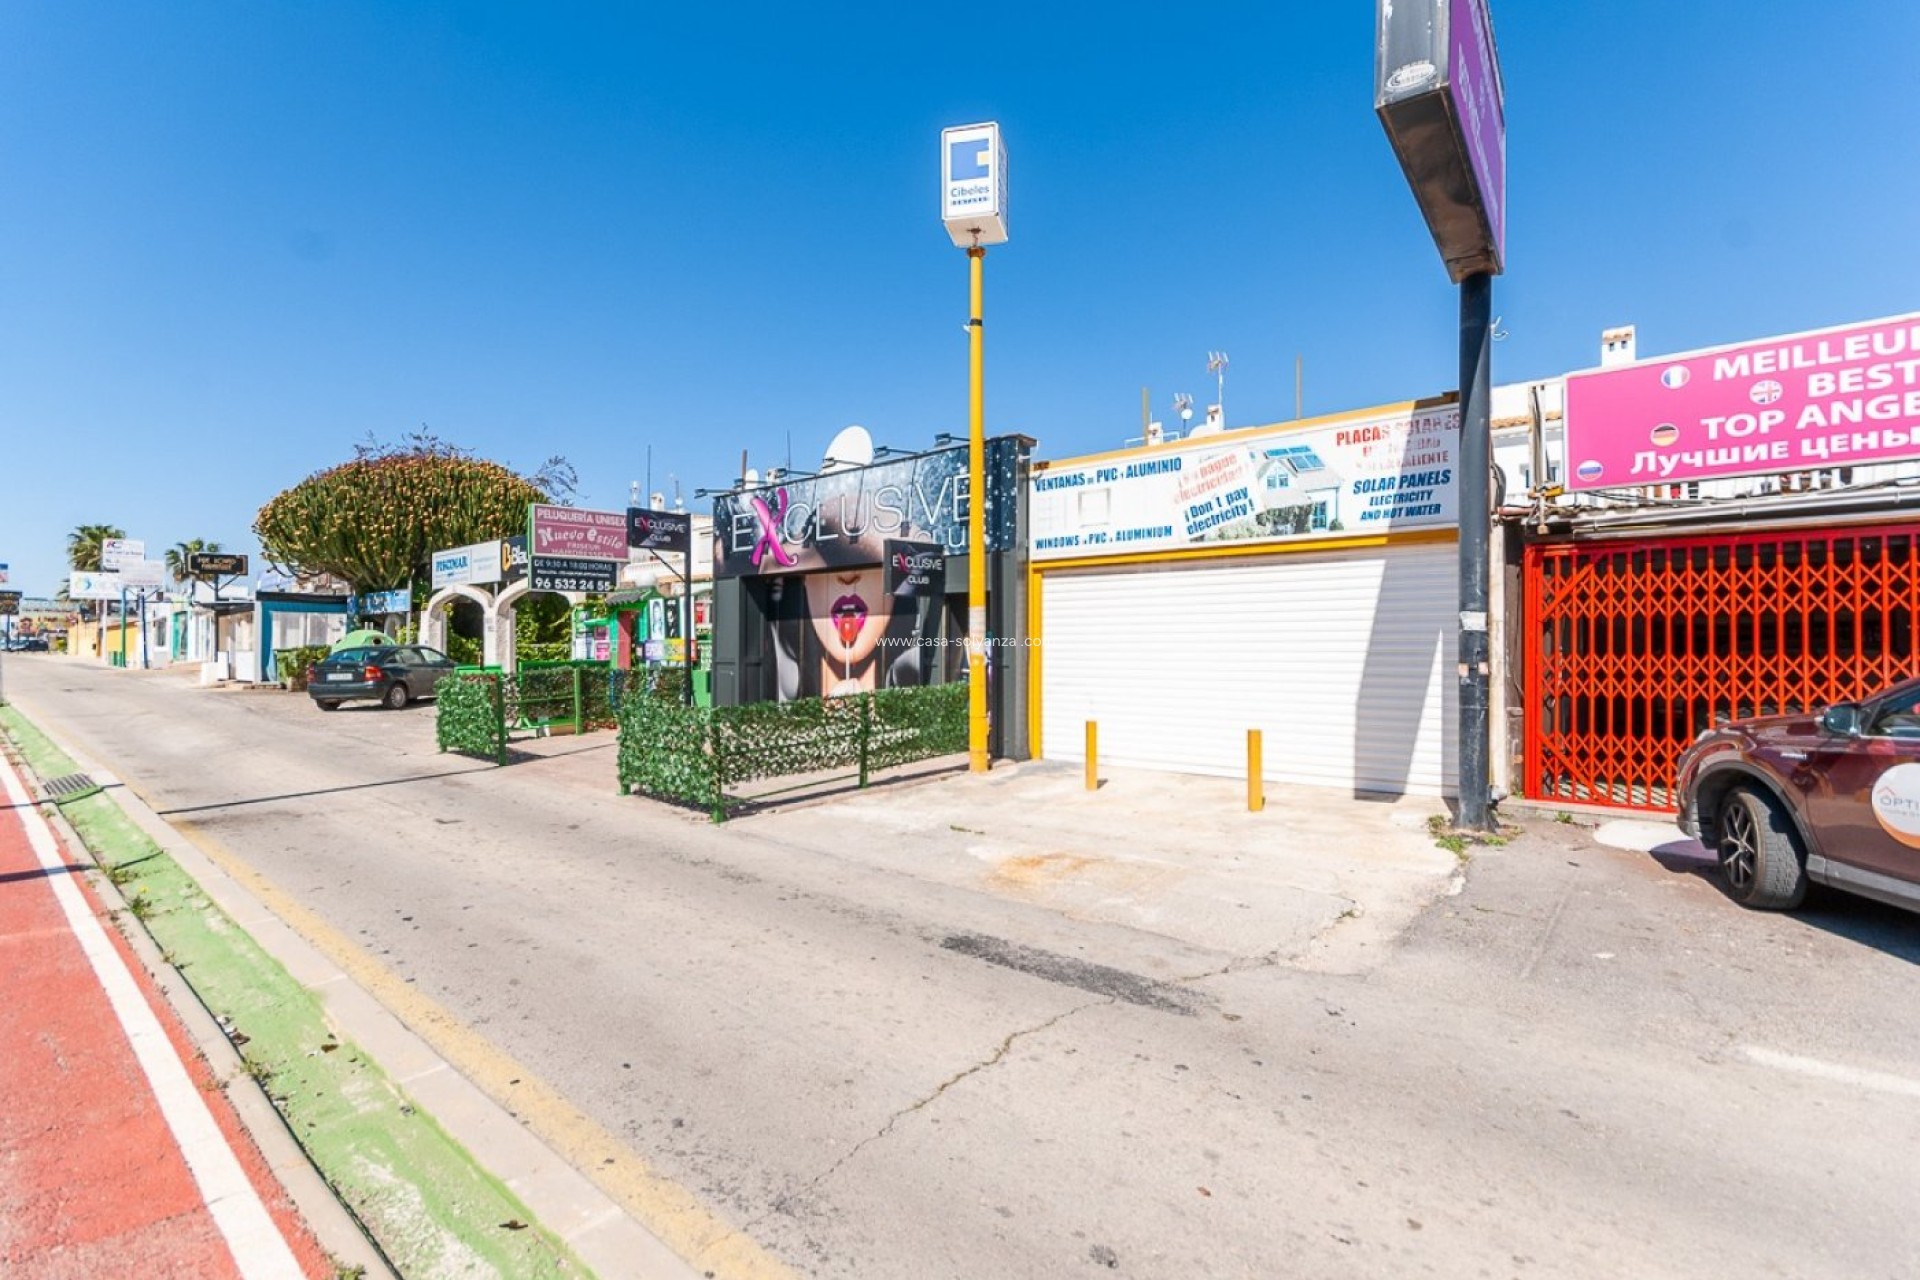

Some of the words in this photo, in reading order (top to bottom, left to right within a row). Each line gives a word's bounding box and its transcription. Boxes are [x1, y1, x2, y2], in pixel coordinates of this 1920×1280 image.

[951, 185, 990, 198] Cibeles
[1808, 358, 1920, 398] BEST
[1700, 410, 1785, 440] TOP
[1796, 391, 1920, 429] ANGE
[1035, 472, 1086, 492] VENTANAS
[1096, 467, 1118, 483] PVC
[1125, 457, 1182, 479] ALUMINIO
[1353, 476, 1396, 494] SOLAR
[1399, 469, 1451, 489] PANELS
[1225, 487, 1248, 506] pay
[1369, 489, 1433, 506] ELECTRICITY
[732, 472, 986, 567] EXCLUSIVE
[1361, 509, 1381, 520] AND
[1383, 507, 1403, 519] HOT
[1405, 504, 1441, 517] WATER
[635, 517, 687, 534] EXCLUSIVE
[538, 526, 584, 547] Nuevo
[650, 534, 673, 543] CLUB
[1035, 535, 1080, 550] WINDOWS
[1088, 532, 1107, 544] PVC
[1115, 525, 1172, 541] ALUMINIUM
[892, 552, 943, 571] EXCLUSIVE
[535, 577, 551, 590] 96
[554, 578, 577, 590] 532
[579, 579, 595, 591] 24
[597, 580, 612, 592] 55
[907, 575, 930, 584] CLUB
